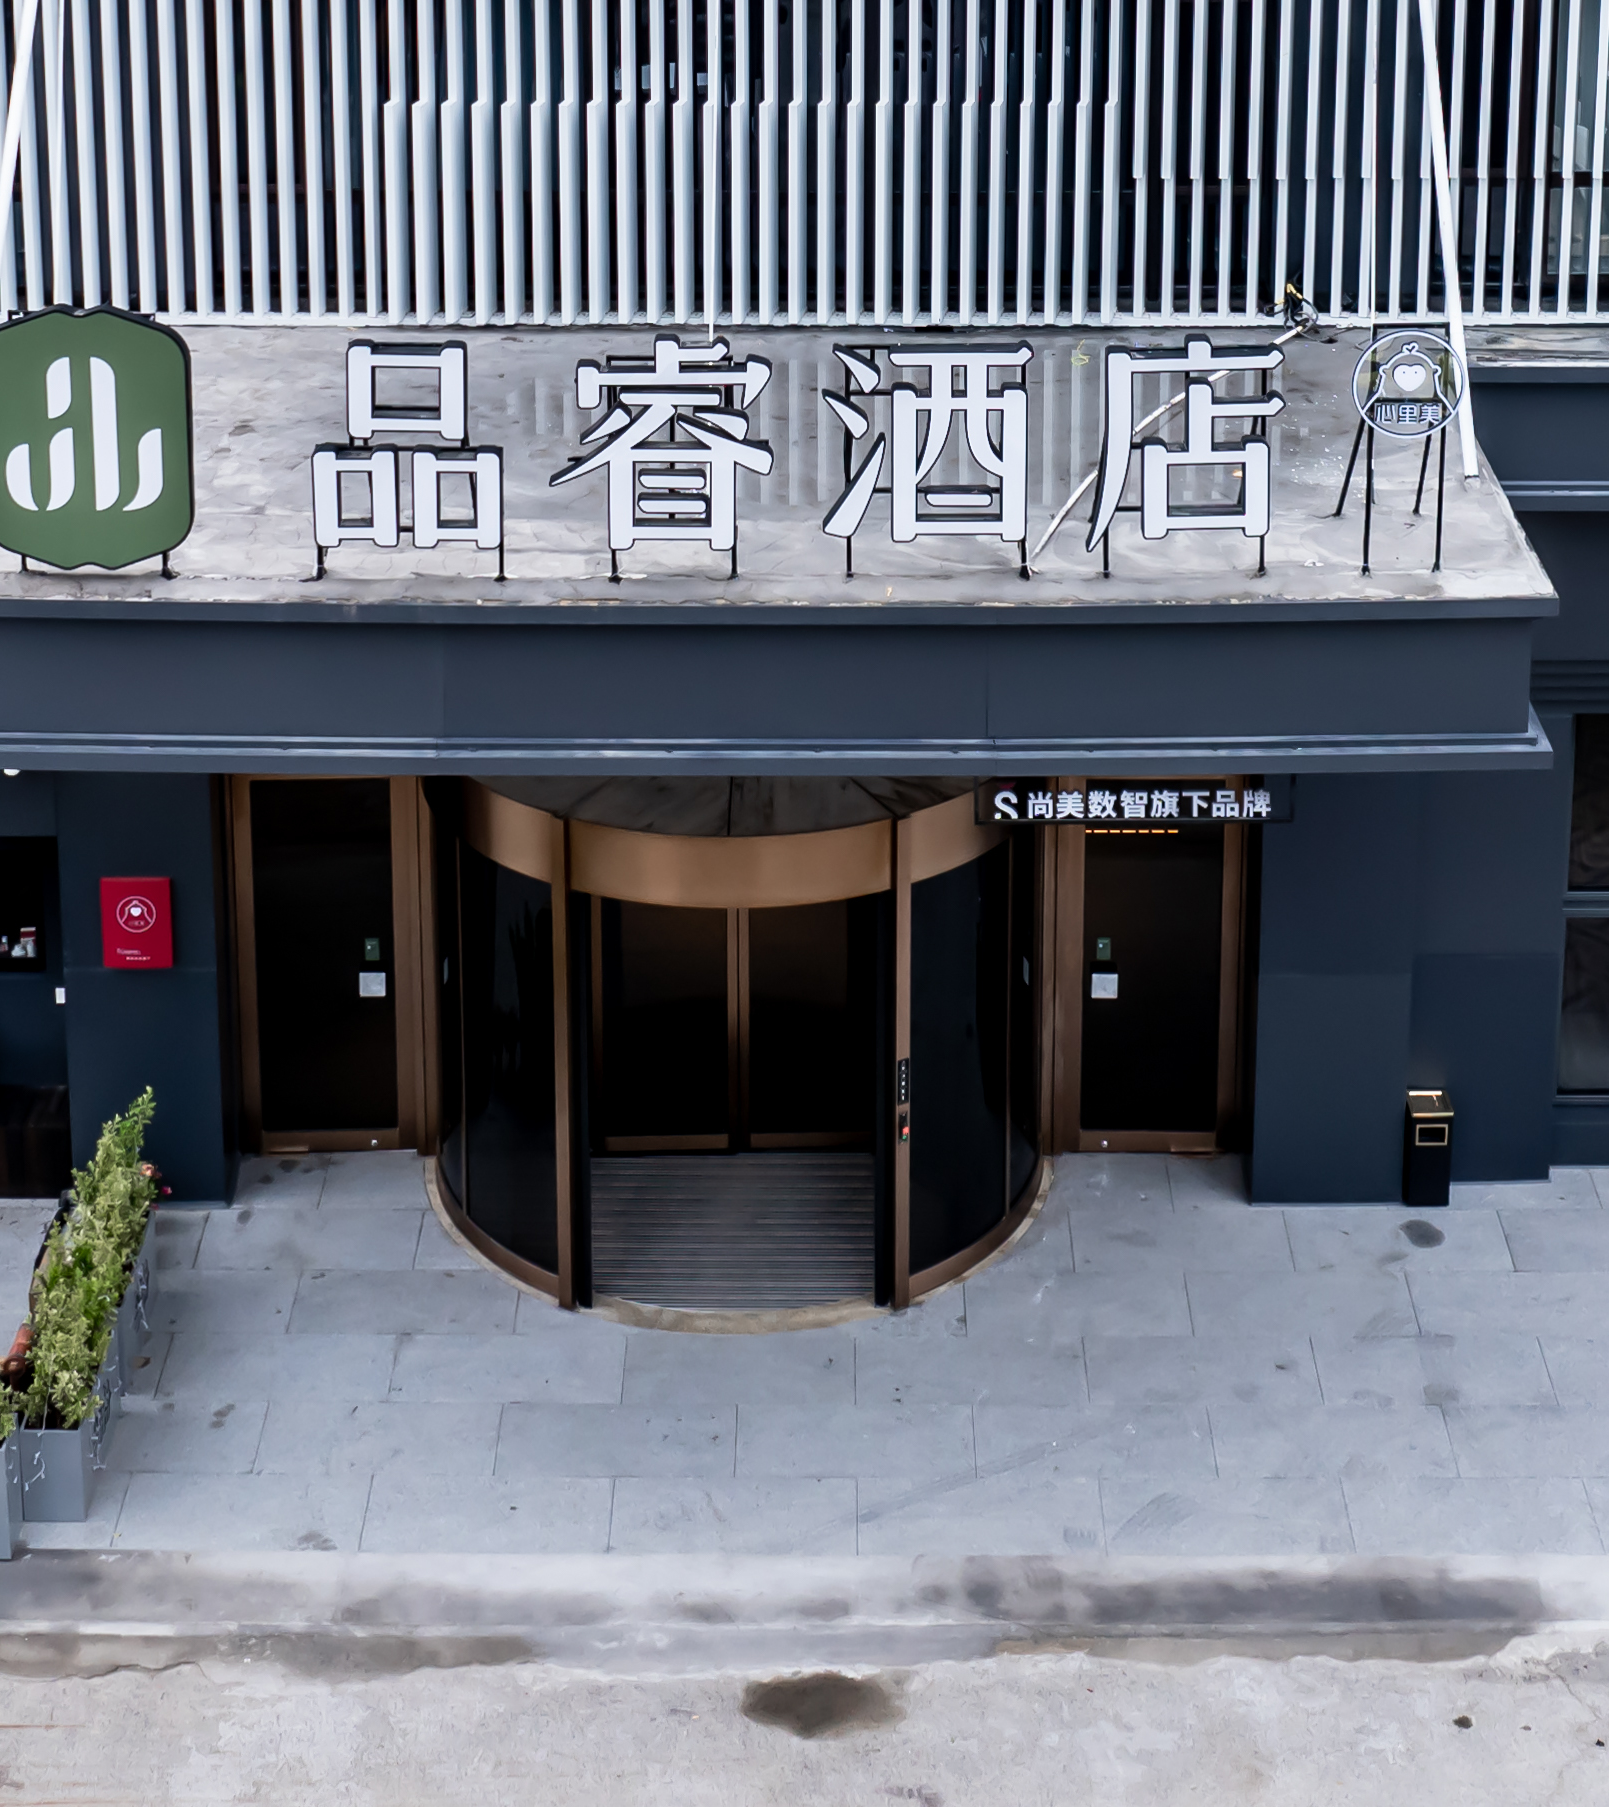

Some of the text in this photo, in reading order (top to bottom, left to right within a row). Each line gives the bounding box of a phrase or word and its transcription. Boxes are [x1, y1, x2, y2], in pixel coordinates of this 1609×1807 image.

[1375, 403, 1441, 424] 心里美
[311, 335, 1285, 555] 品睿酒店
[1027, 790, 1273, 819] 尚美数智旗下品牌
